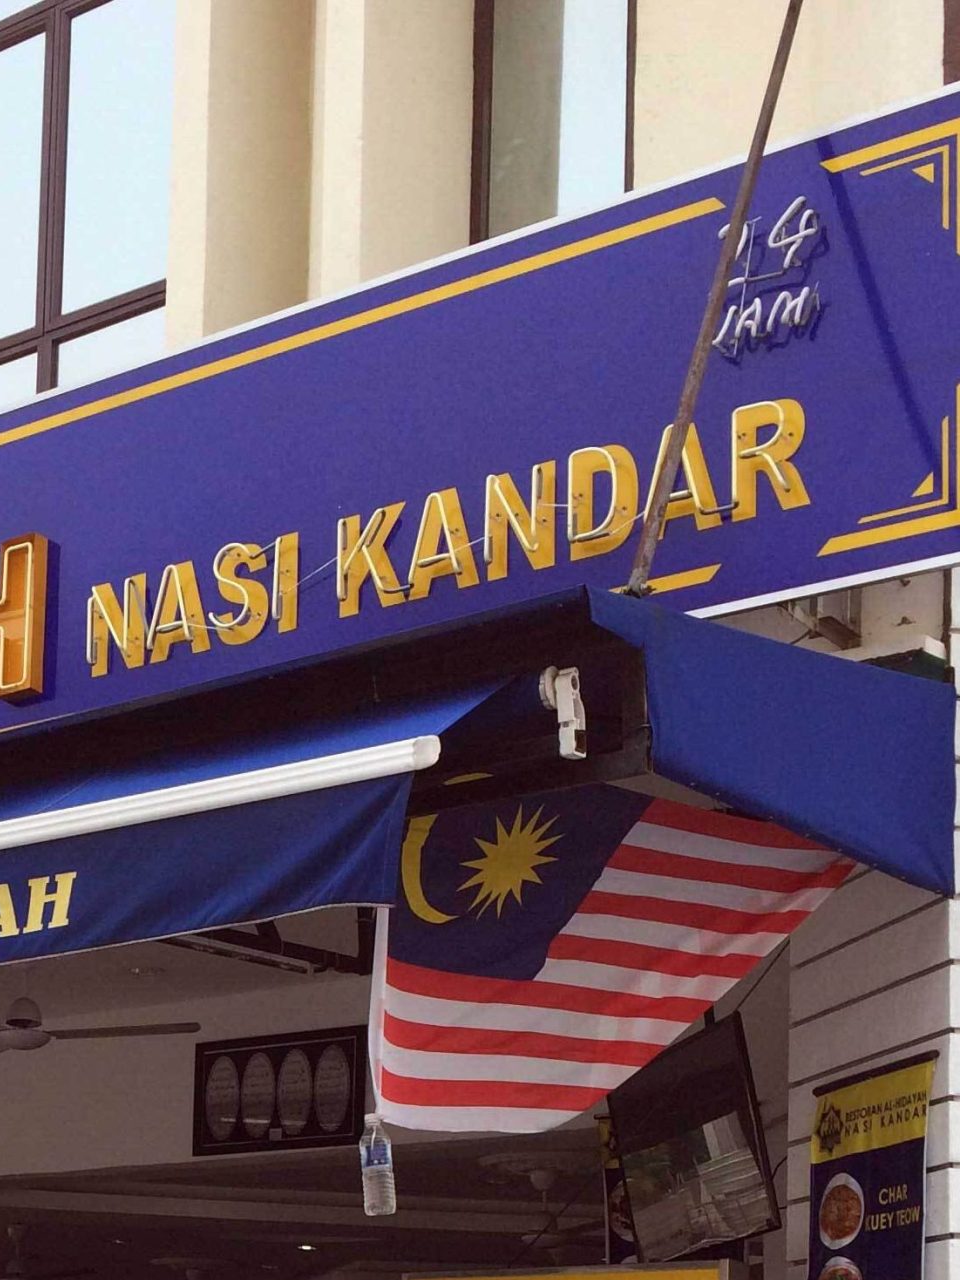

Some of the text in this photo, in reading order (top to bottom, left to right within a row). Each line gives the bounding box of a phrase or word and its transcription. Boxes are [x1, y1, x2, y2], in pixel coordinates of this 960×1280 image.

[86, 531, 301, 678] NASI
[337, 398, 811, 619] KANDAR
[844, 1119, 873, 1137] NASI
[881, 1104, 927, 1129] KANDAR
[845, 1103, 882, 1122] RESTORAN
[878, 1184, 908, 1205] CHAR
[865, 1205, 921, 1232] KUEY TEOW
